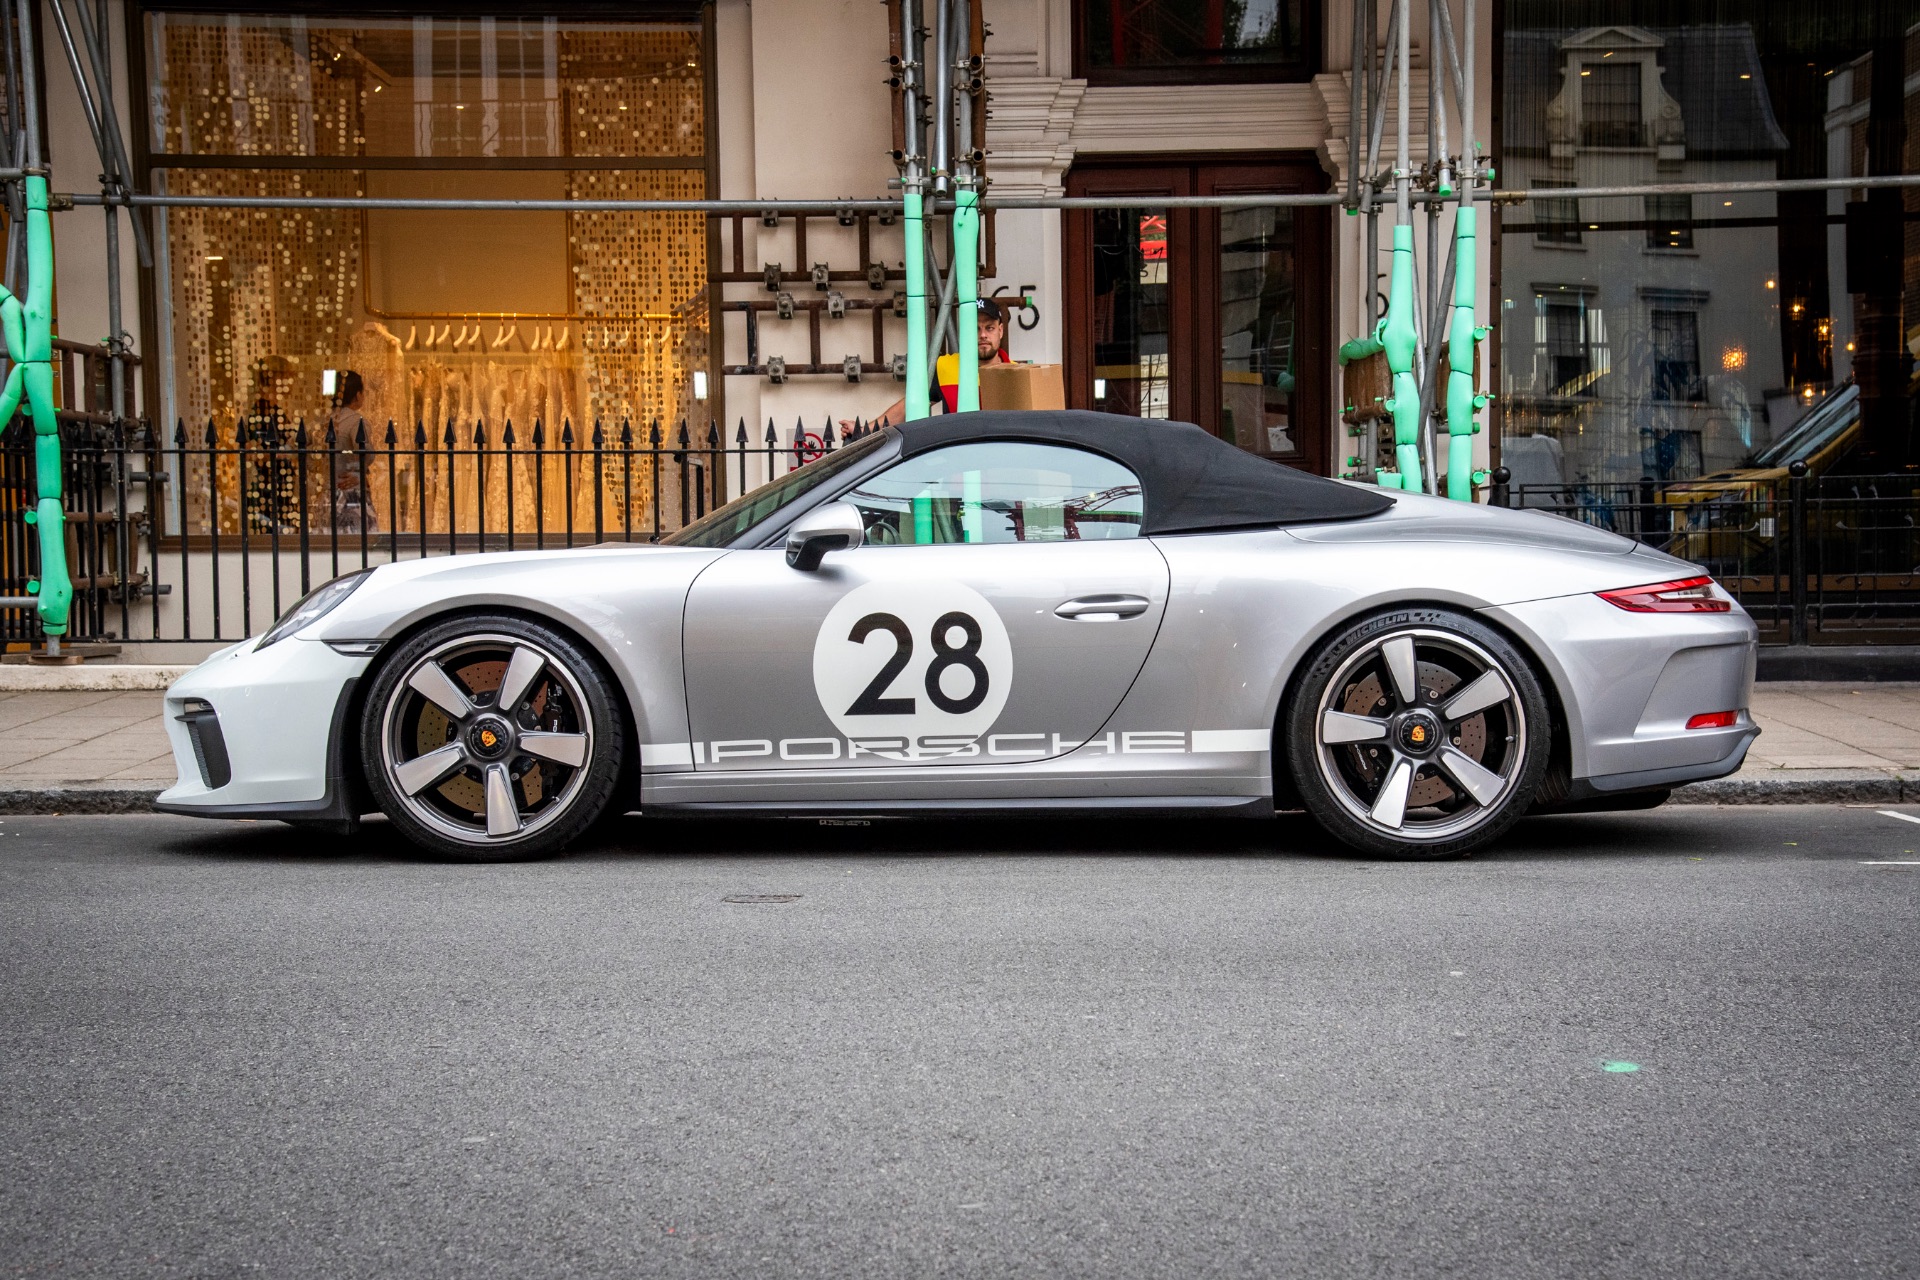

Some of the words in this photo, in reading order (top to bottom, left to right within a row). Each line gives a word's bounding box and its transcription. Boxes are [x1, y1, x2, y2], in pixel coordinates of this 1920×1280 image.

[1346, 612, 1410, 646] MICHELIN
[844, 611, 990, 716] 28
[711, 731, 1186, 764] PORSCHE
